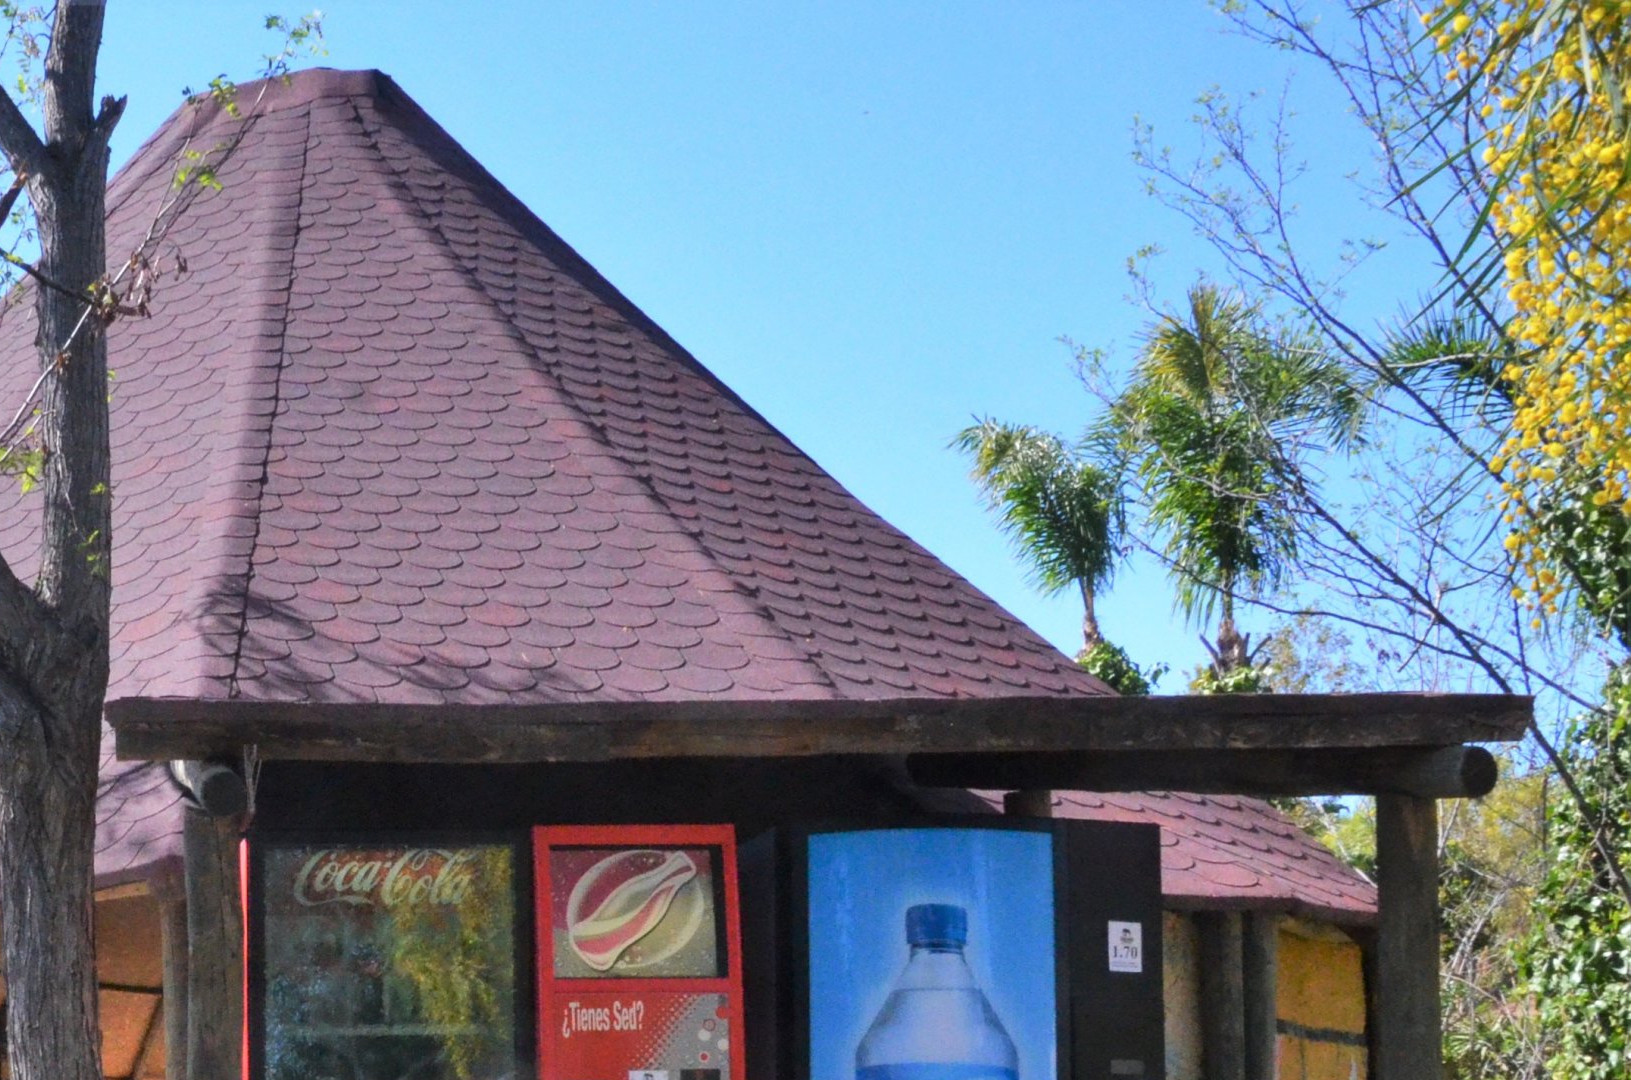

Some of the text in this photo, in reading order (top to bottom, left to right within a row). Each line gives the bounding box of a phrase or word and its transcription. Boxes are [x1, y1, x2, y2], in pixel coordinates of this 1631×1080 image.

[1113, 945, 1138, 959] 1.70
[562, 1000, 644, 1038] ¿Tienes Sed?
